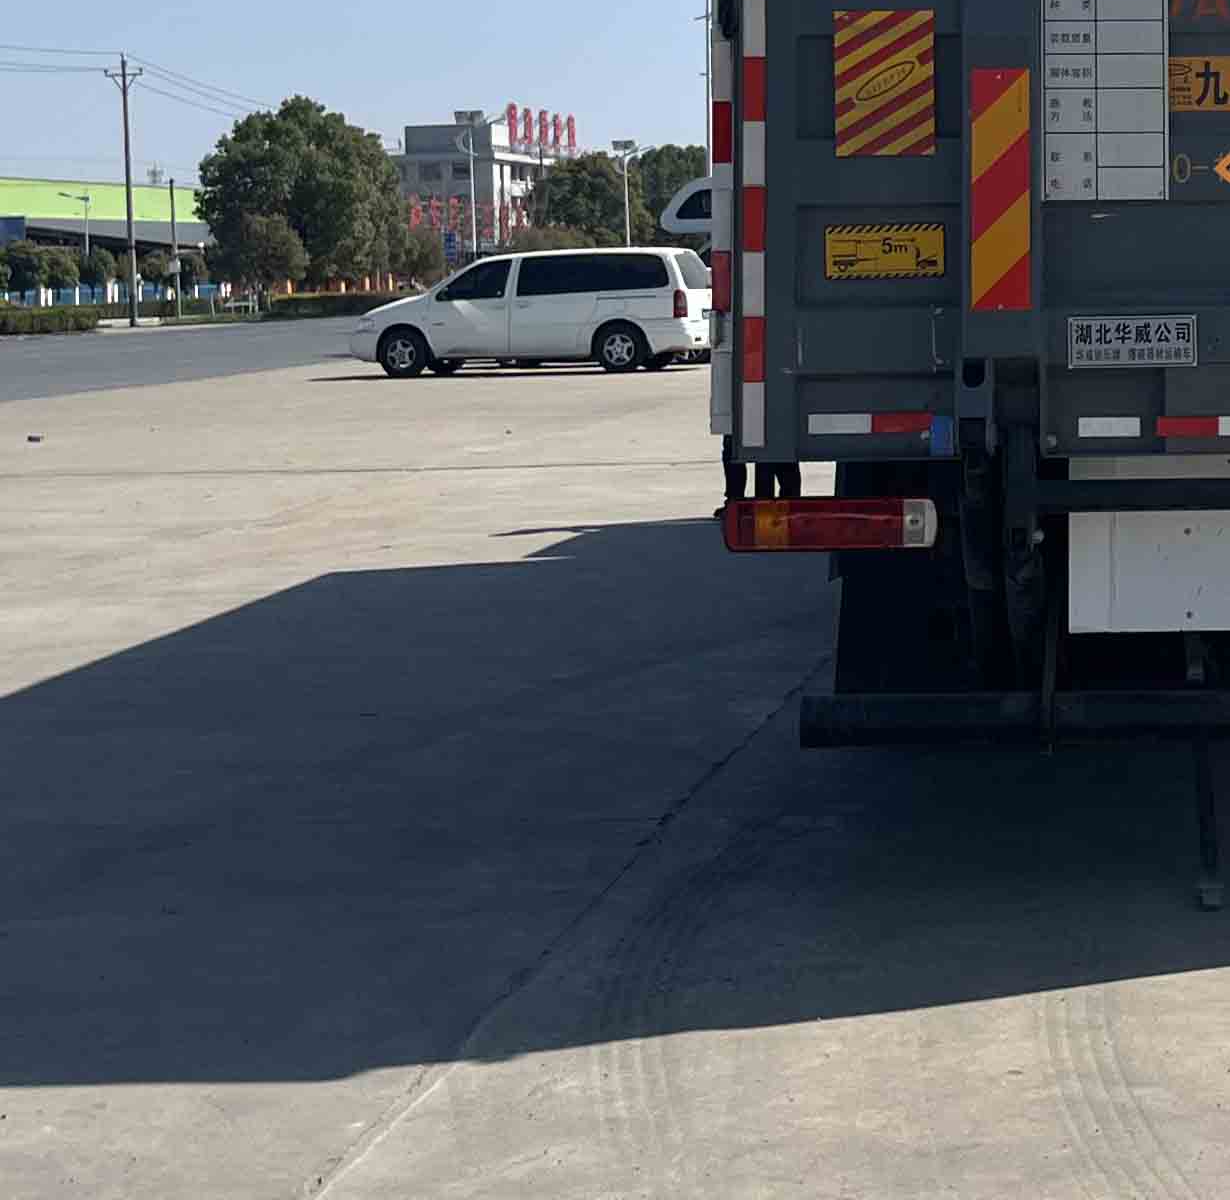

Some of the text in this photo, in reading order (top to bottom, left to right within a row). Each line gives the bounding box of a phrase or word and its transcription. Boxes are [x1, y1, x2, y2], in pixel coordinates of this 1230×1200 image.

[881, 237, 909, 254] 5m
[1075, 321, 1191, 345] 湖北华威公司
